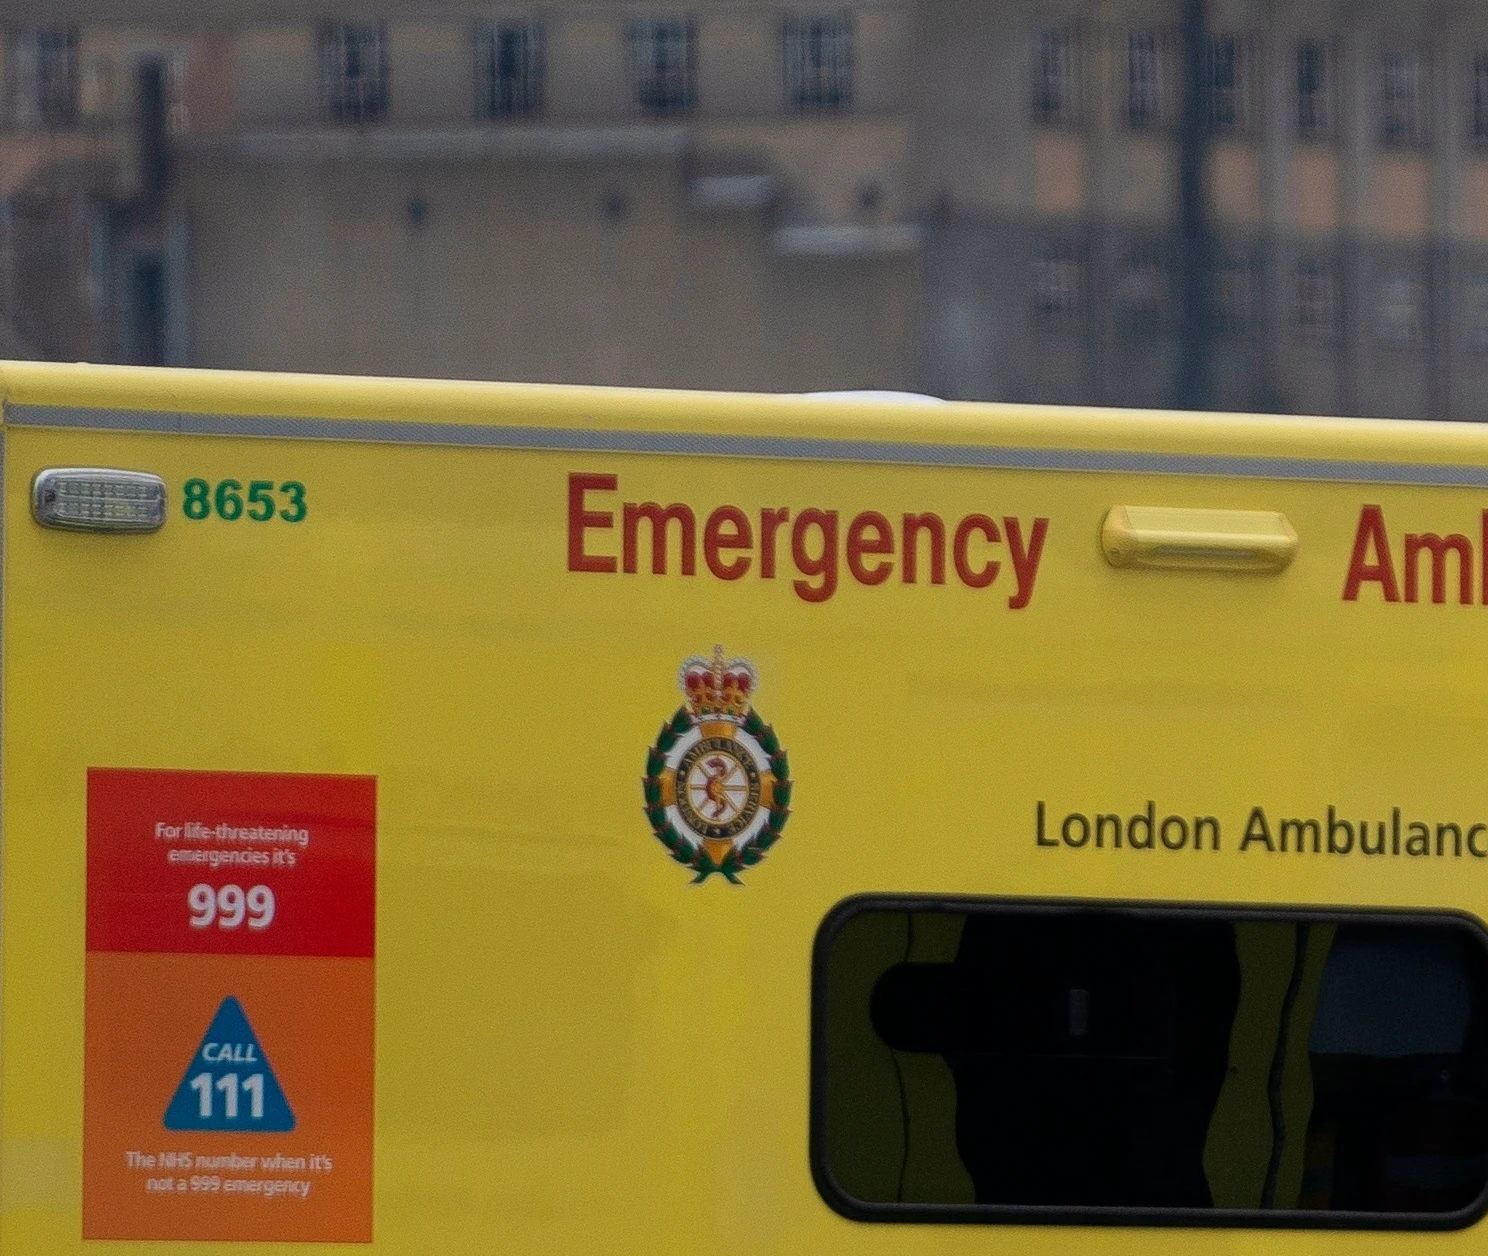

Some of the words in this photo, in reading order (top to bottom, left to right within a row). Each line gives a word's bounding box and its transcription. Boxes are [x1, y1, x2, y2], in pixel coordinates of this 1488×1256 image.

[182, 477, 308, 523] 8653
[566, 472, 1050, 610] Emergency
[155, 822, 183, 840] For
[184, 823, 309, 846] life-threatening
[1036, 799, 1222, 851] London
[167, 848, 269, 867] emergencies
[272, 849, 297, 866] it's
[187, 882, 276, 930] 999
[202, 1042, 257, 1063] CALL
[190, 1072, 265, 1119] 111
[125, 1151, 156, 1169] The
[158, 1152, 193, 1169] NHS
[196, 1153, 258, 1170] number
[260, 1153, 305, 1171] when
[308, 1154, 333, 1171] it's
[146, 1177, 176, 1193] not
[177, 1180, 187, 1193] a
[189, 1176, 220, 1193] 999
[222, 1179, 311, 1198] emergency
